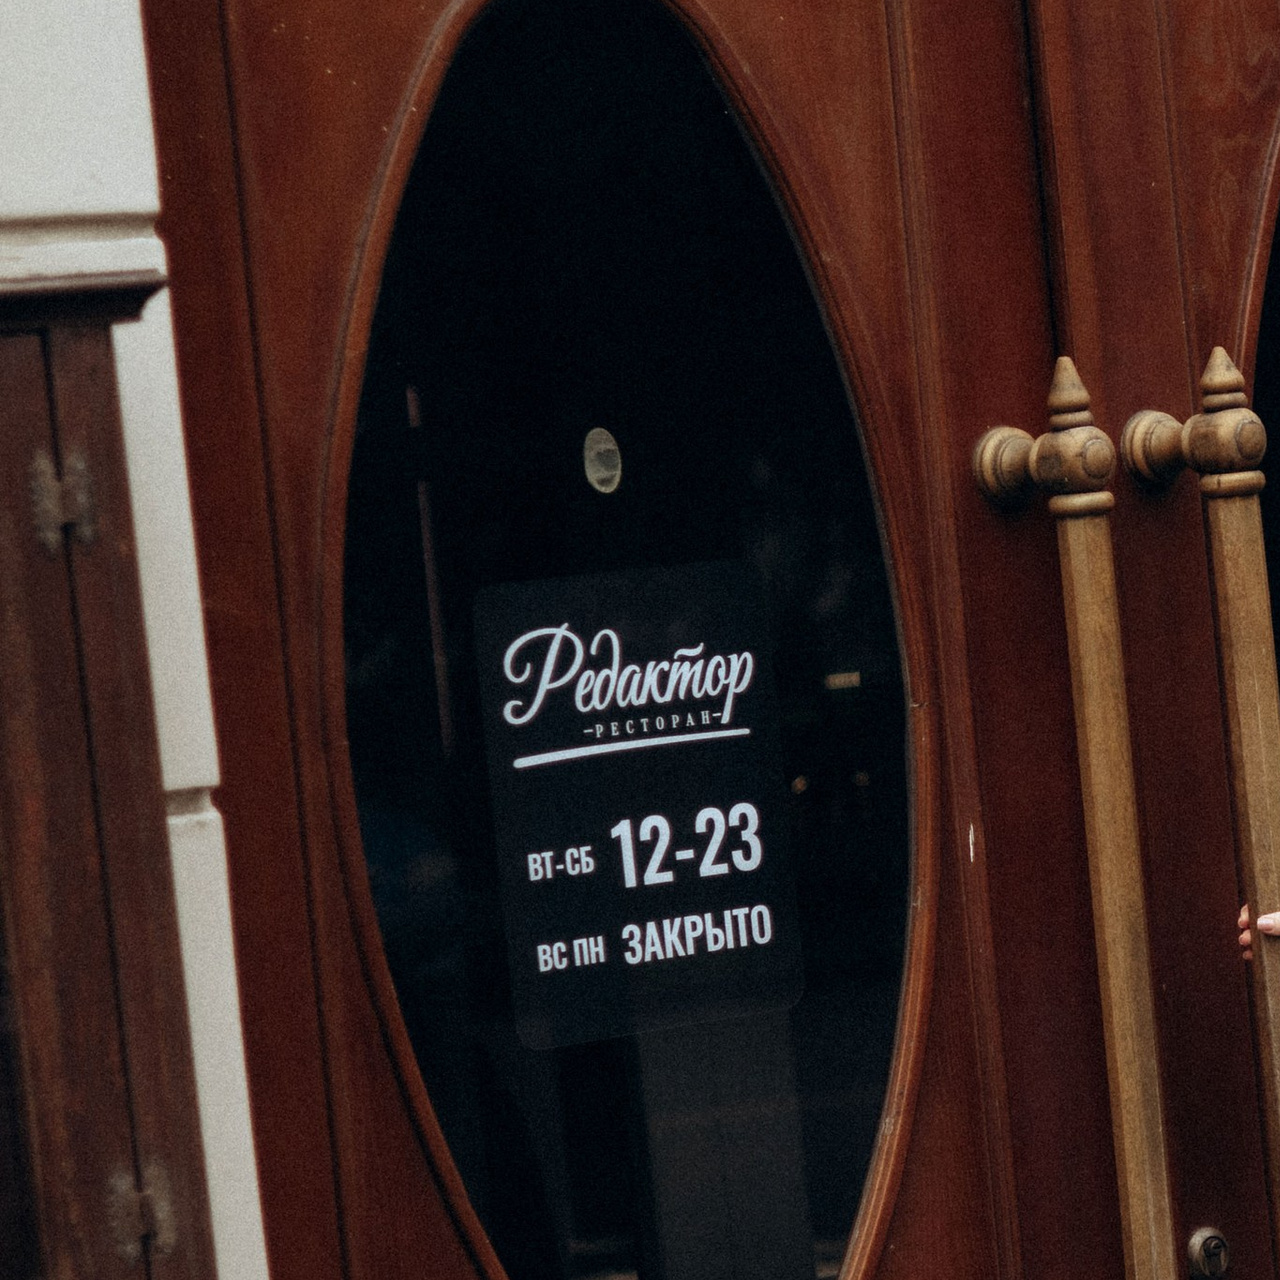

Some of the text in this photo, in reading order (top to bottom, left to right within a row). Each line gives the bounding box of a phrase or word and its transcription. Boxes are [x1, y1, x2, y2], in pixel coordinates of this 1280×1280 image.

[502, 622, 755, 726] Редактор
[527, 802, 763, 889] ВТ-СБ 12-23
[536, 904, 772, 973] ВС ПН ЗАКРЫТО
